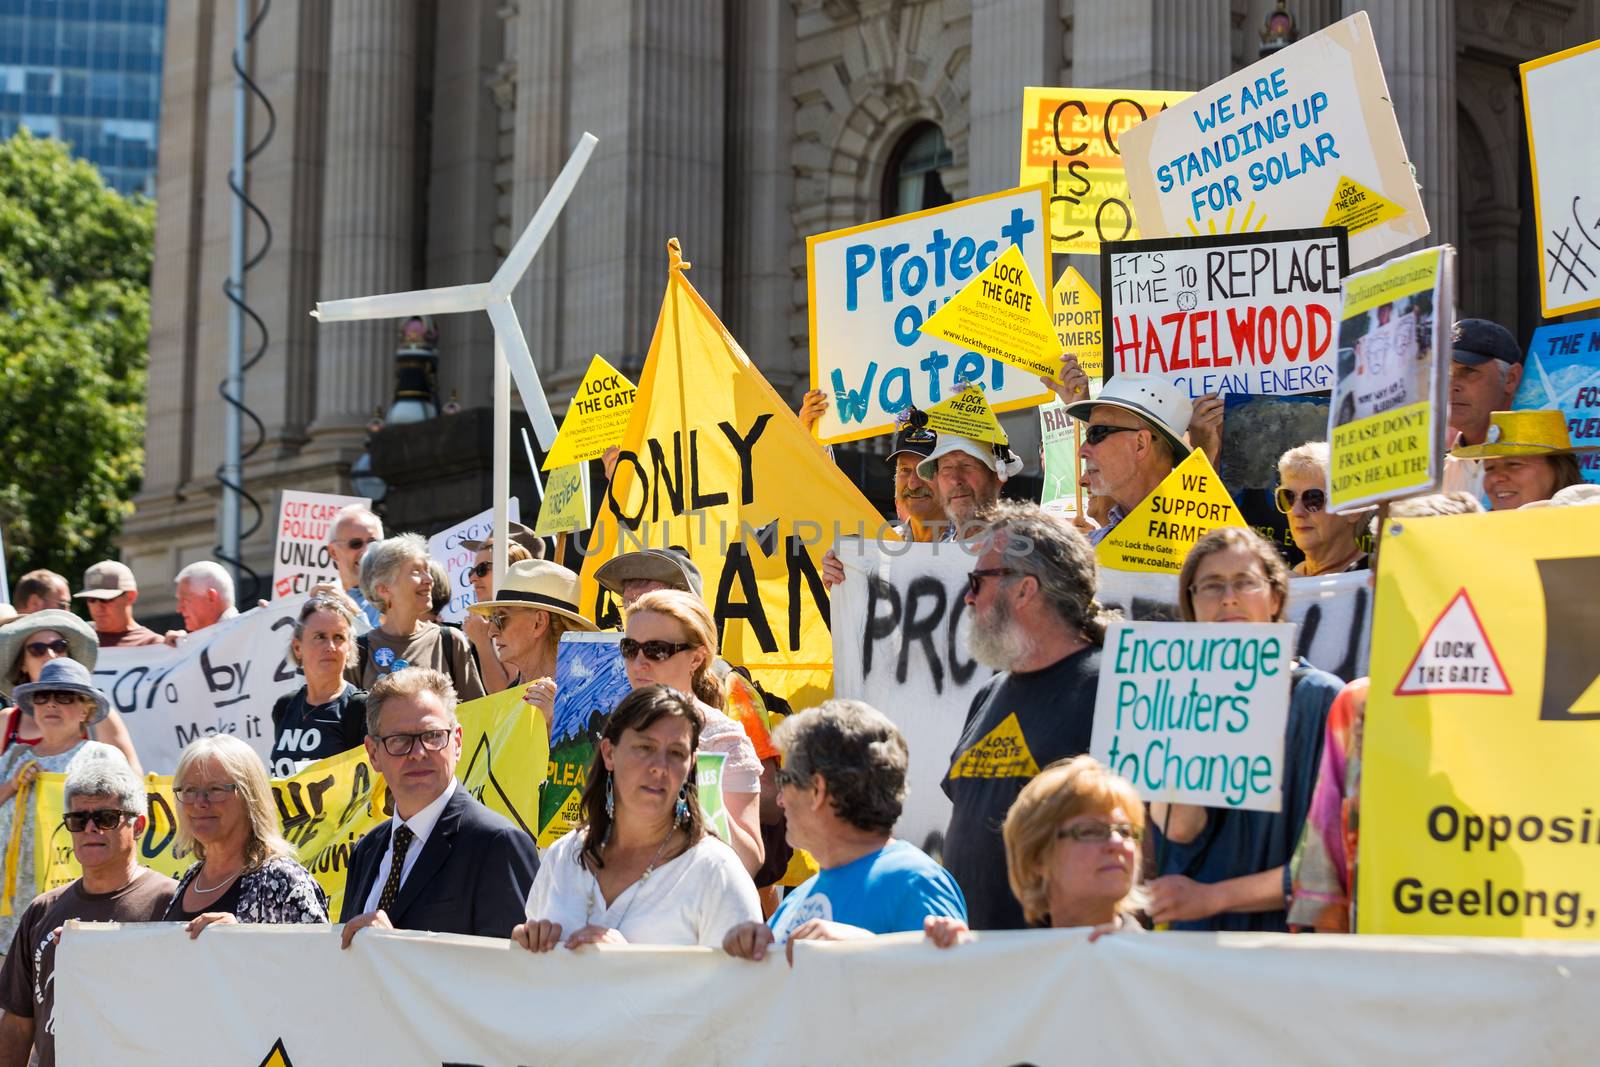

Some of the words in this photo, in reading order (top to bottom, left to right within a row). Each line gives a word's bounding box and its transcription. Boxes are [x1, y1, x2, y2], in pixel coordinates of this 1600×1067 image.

[1193, 94, 1235, 133] WE
[1240, 67, 1288, 115] ARE
[1053, 98, 1168, 157] CO
[1156, 108, 1291, 193] STANDING
[1292, 91, 1328, 129] UP
[1053, 160, 1091, 197] IS
[1191, 174, 1243, 222] FOR
[1248, 132, 1340, 191] SOLAR
[1334, 197, 1349, 212] THE
[1349, 191, 1367, 205] GATE
[1339, 185, 1358, 200] LOCK
[994, 262, 1024, 287] LOCK
[1113, 252, 1166, 278] IT'S
[1175, 263, 1198, 288] TO
[1206, 243, 1340, 301] REPLACE
[982, 279, 1003, 302] THE
[1004, 288, 1033, 313] GATE
[1060, 290, 1080, 306] WE
[1113, 277, 1169, 305] TIME
[943, 328, 1055, 376] www.lockthegate.org.au/victoria
[1113, 303, 1332, 374] HAZELWOOD
[1547, 333, 1584, 356] THE
[585, 375, 620, 396] LOCK
[961, 394, 984, 405] LOCK
[575, 397, 602, 416] THE
[949, 400, 966, 411] THE
[965, 403, 987, 415] GATE
[1334, 422, 1380, 449] PLEASE
[1383, 410, 1426, 434] DON'T
[1338, 443, 1381, 470] FRACK
[1386, 434, 1419, 456] OUR
[607, 413, 774, 532] ONLY
[1182, 473, 1208, 493] WE
[1365, 456, 1428, 484] HEALTH!
[284, 501, 308, 518] CUT
[311, 503, 343, 521] CAR
[1151, 496, 1231, 522] SUPPORT
[445, 524, 479, 550] CSG
[1124, 541, 1142, 550] Lock
[1142, 542, 1155, 551] the
[1155, 544, 1173, 555] Gate
[1114, 628, 1281, 692] Encourage
[1433, 640, 1477, 659] LOCK
[200, 646, 252, 695] by
[1417, 665, 1445, 685] THE
[1449, 665, 1491, 685] GATE
[1115, 677, 1250, 734] Polluters
[246, 714, 262, 738] it
[276, 728, 322, 752] NO
[1143, 736, 1273, 806] Change
[561, 812, 571, 821] THE
[1427, 804, 1600, 852] Opposi
[1392, 877, 1596, 929] Geelong,
